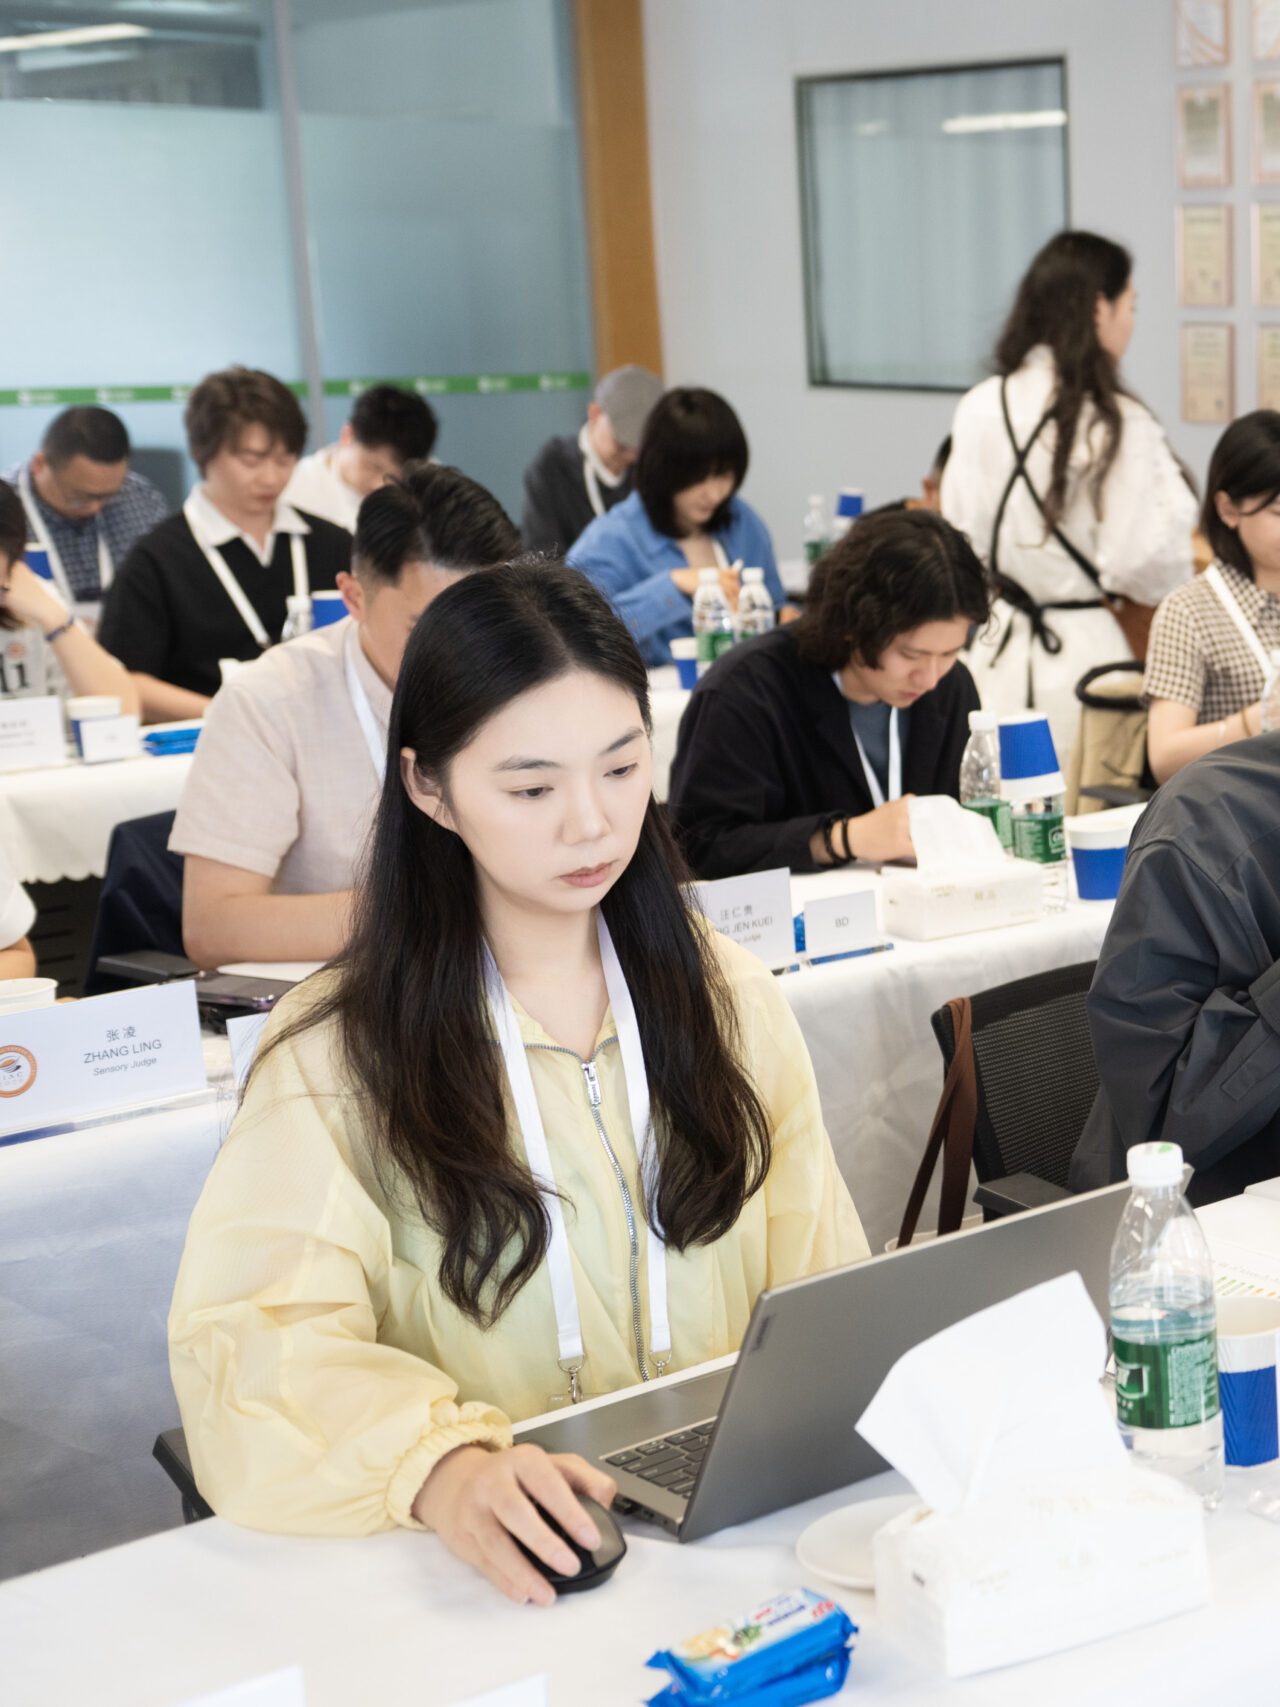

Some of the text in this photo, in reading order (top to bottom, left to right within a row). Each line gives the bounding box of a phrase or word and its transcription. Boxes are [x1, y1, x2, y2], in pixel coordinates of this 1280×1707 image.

[83, 1039, 162, 1064] ZHANG LING
[93, 1056, 157, 1077] Sensory Judge
